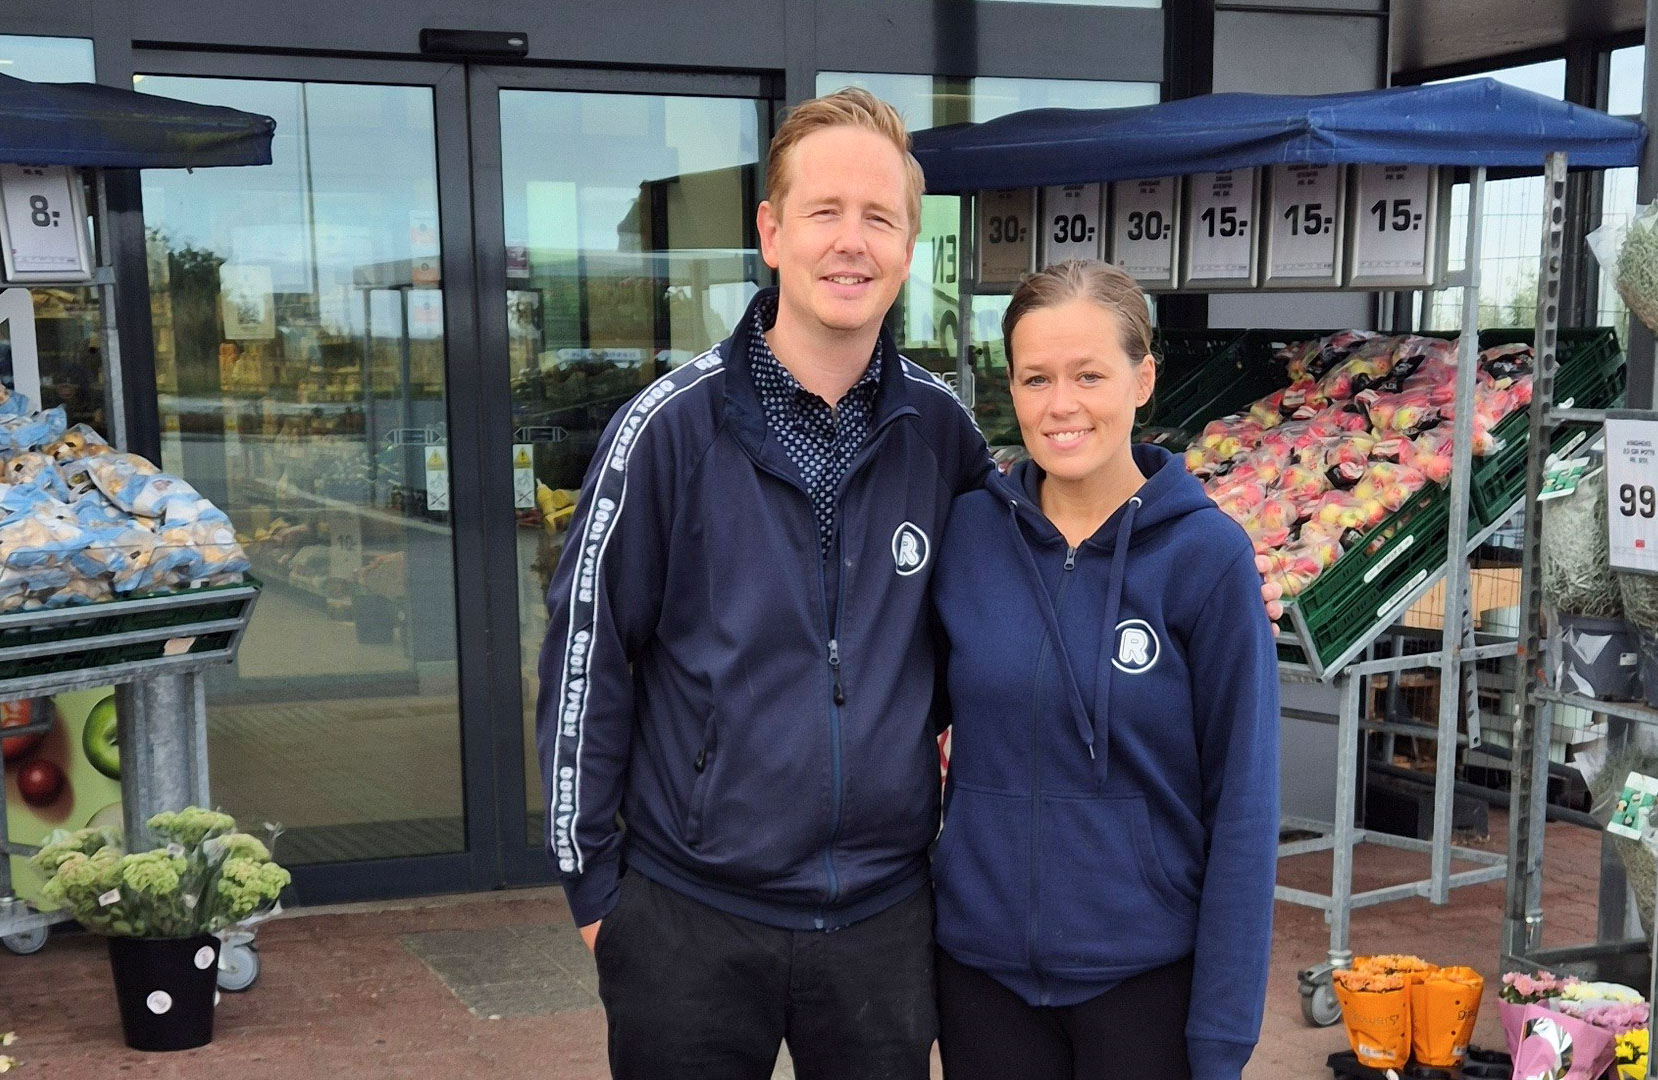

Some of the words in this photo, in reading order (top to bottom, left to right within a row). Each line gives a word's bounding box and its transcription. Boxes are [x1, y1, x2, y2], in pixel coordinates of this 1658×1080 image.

[611, 415, 642, 472] REMA
[642, 379, 676, 414] 1000
[1620, 484, 1656, 518] 99
[579, 543, 597, 603] REMA
[589, 498, 616, 541] 1000
[899, 531, 919, 566] R
[571, 630, 590, 675] 1000
[1119, 628, 1148, 664] R
[563, 677, 584, 737] REMA
[558, 766, 573, 812] 1000
[556, 814, 575, 873] REMA
